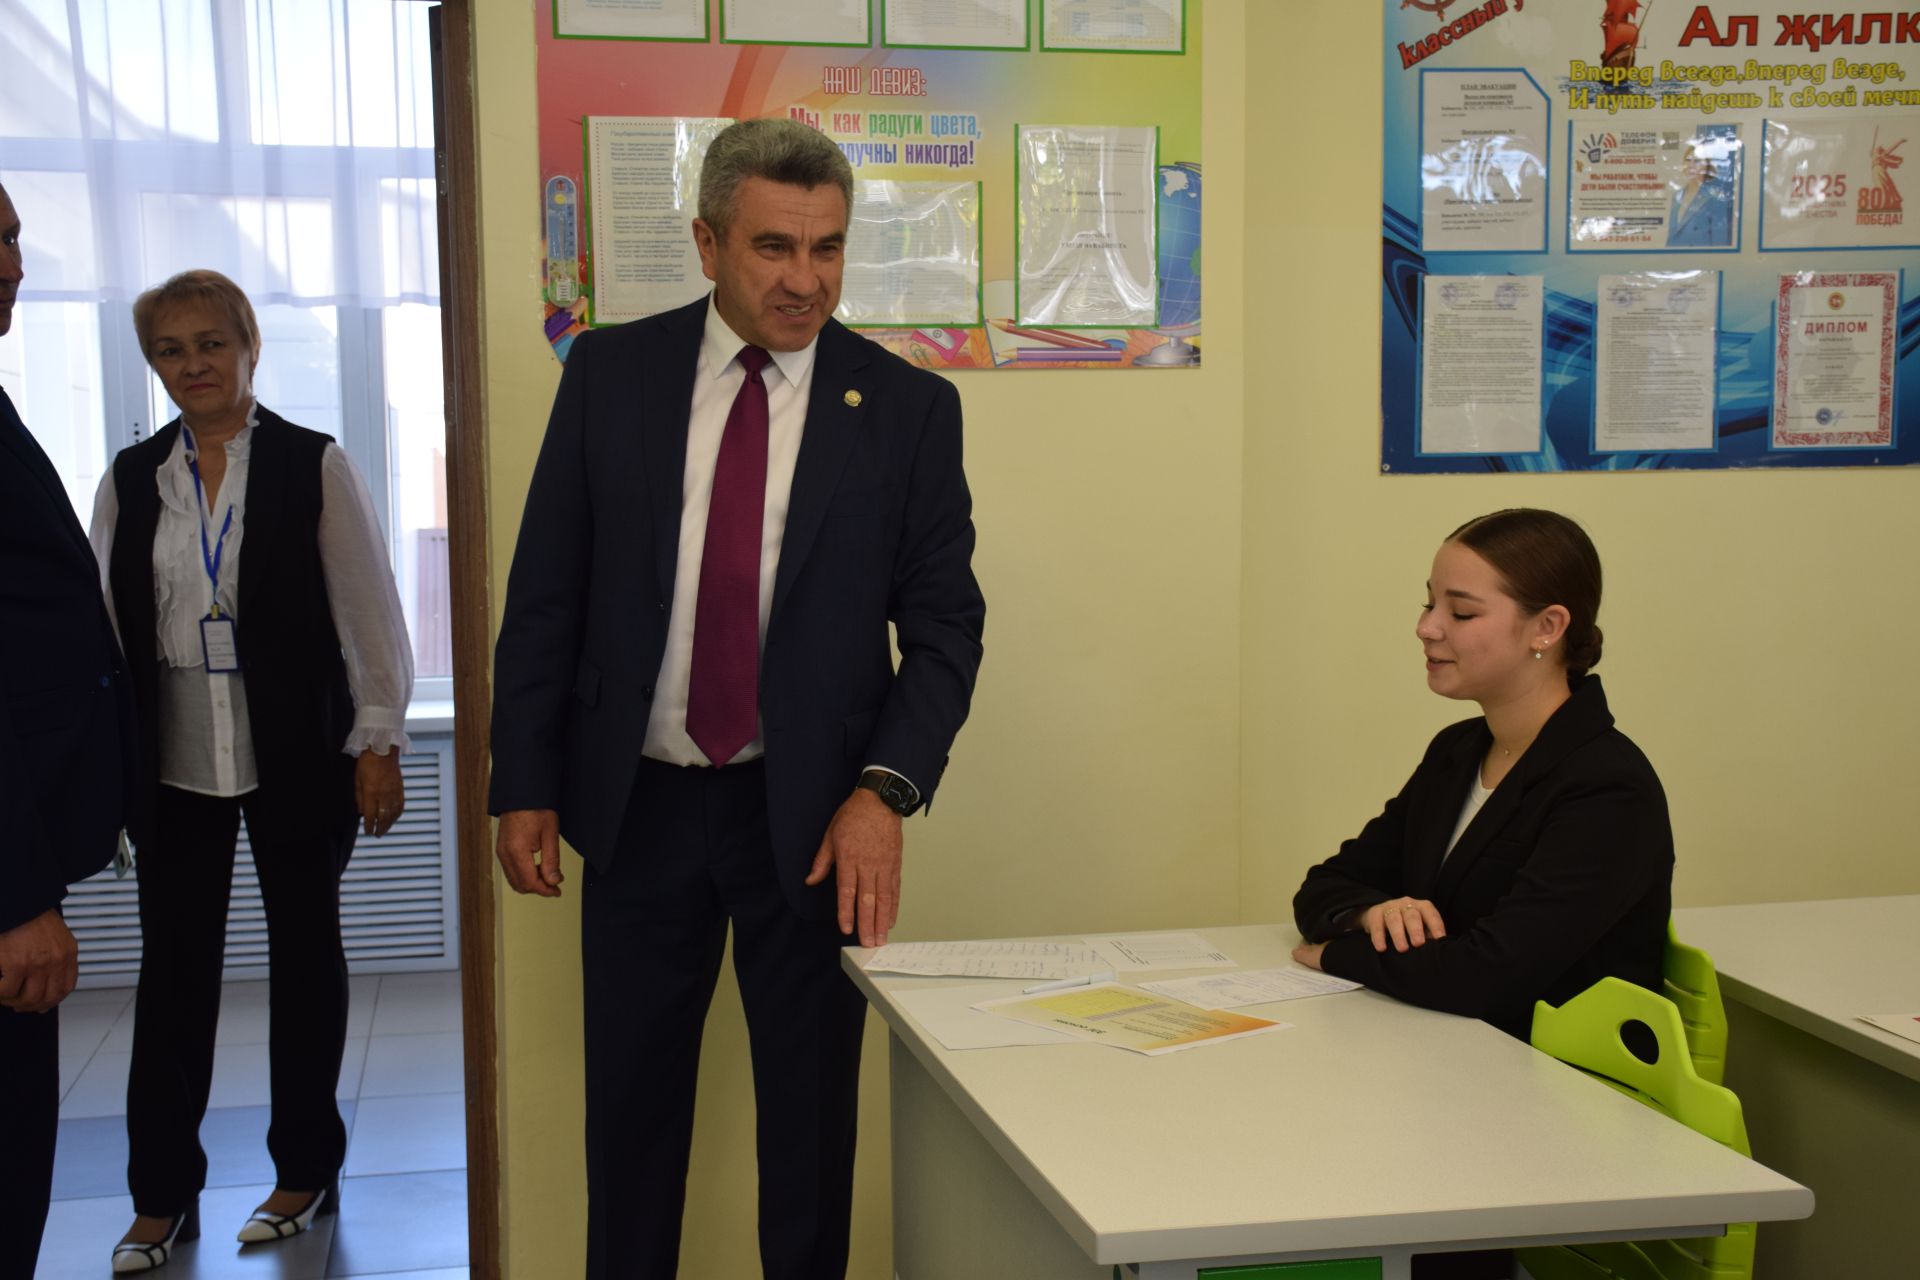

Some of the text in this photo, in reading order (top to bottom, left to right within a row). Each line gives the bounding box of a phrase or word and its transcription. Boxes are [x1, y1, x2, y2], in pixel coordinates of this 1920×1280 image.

[1678, 6, 1759, 47] Ал
[823, 66, 927, 96] НАШ ДЕВИЗ:
[1570, 60, 1653, 86] Вперед
[1833, 57, 1905, 84] везде,
[1568, 88, 1590, 110] И
[1594, 93, 1656, 115] путь
[1661, 88, 1762, 114] найдешь
[1790, 85, 1857, 108] своей
[833, 113, 861, 133] как
[869, 113, 923, 138] радуги
[930, 114, 982, 139] цвета,
[905, 140, 974, 168] никогда!
[1791, 174, 1847, 198] 2025
[1857, 187, 1883, 209] 80
[1856, 214, 1904, 227] ПОБЕДА!
[1804, 321, 1869, 335] ДИПЛОМ
